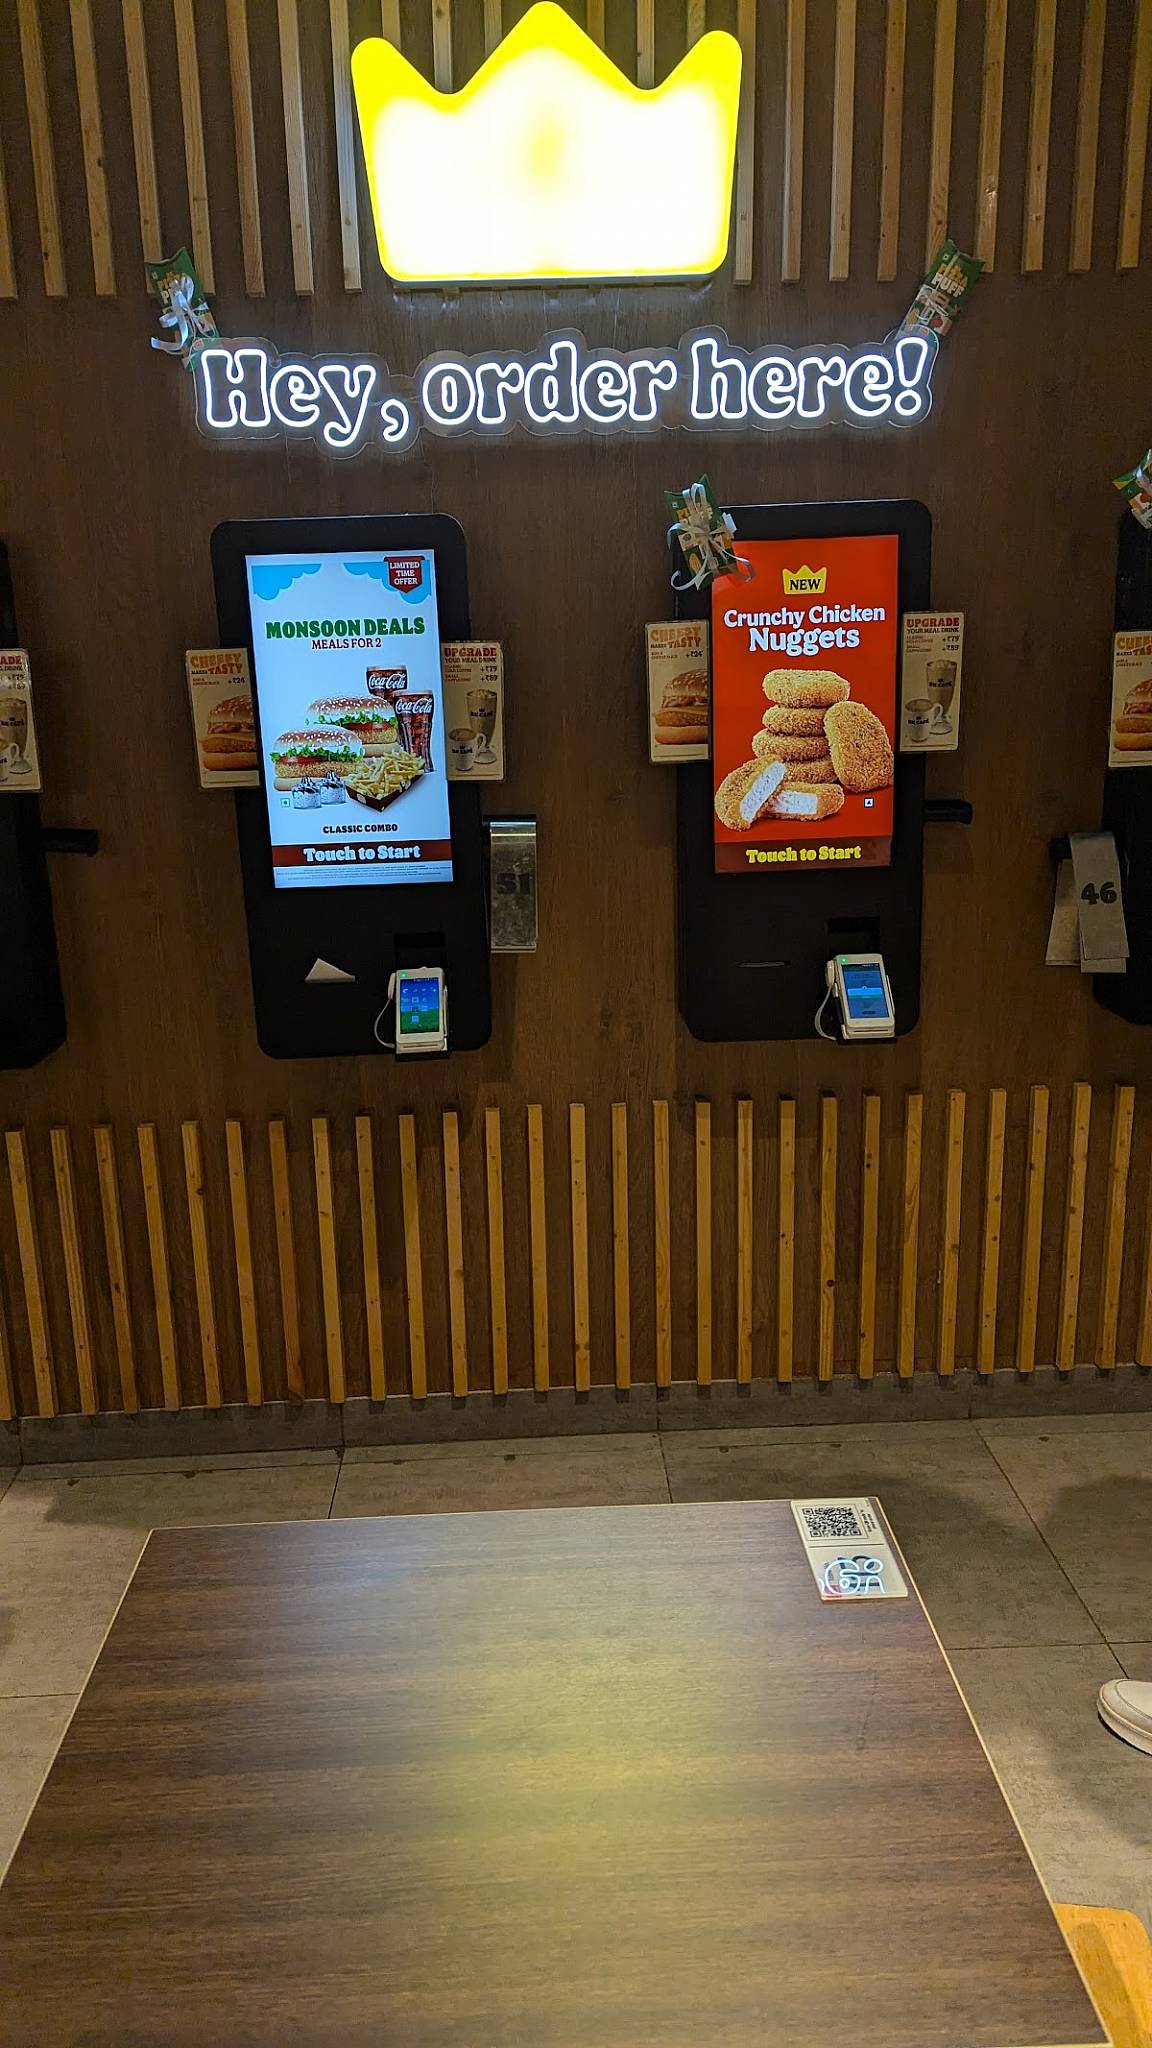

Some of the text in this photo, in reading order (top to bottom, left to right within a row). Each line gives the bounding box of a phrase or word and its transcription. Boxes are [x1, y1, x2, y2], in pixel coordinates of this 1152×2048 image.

[201, 337, 928, 447] Hey, order here!
[789, 579, 821, 591] NEW
[723, 604, 886, 628] Crunchy Chicken
[906, 617, 960, 627] UPGRADE
[266, 617, 425, 639] MONSOON DEALS
[312, 638, 382, 649] MEALS FOR 2
[668, 636, 702, 648] TASTY
[749, 627, 860, 657] Nuggets
[444, 647, 497, 657] UPGRADE
[208, 663, 242, 674] TASTY
[369, 673, 407, 690] Coca-Cola
[395, 697, 433, 714] Coca-Cola
[323, 823, 398, 834] CLASSIC COMBO
[303, 845, 421, 862] Touch to Start
[746, 845, 861, 863] Touch to Start
[1081, 881, 1118, 905] 46
